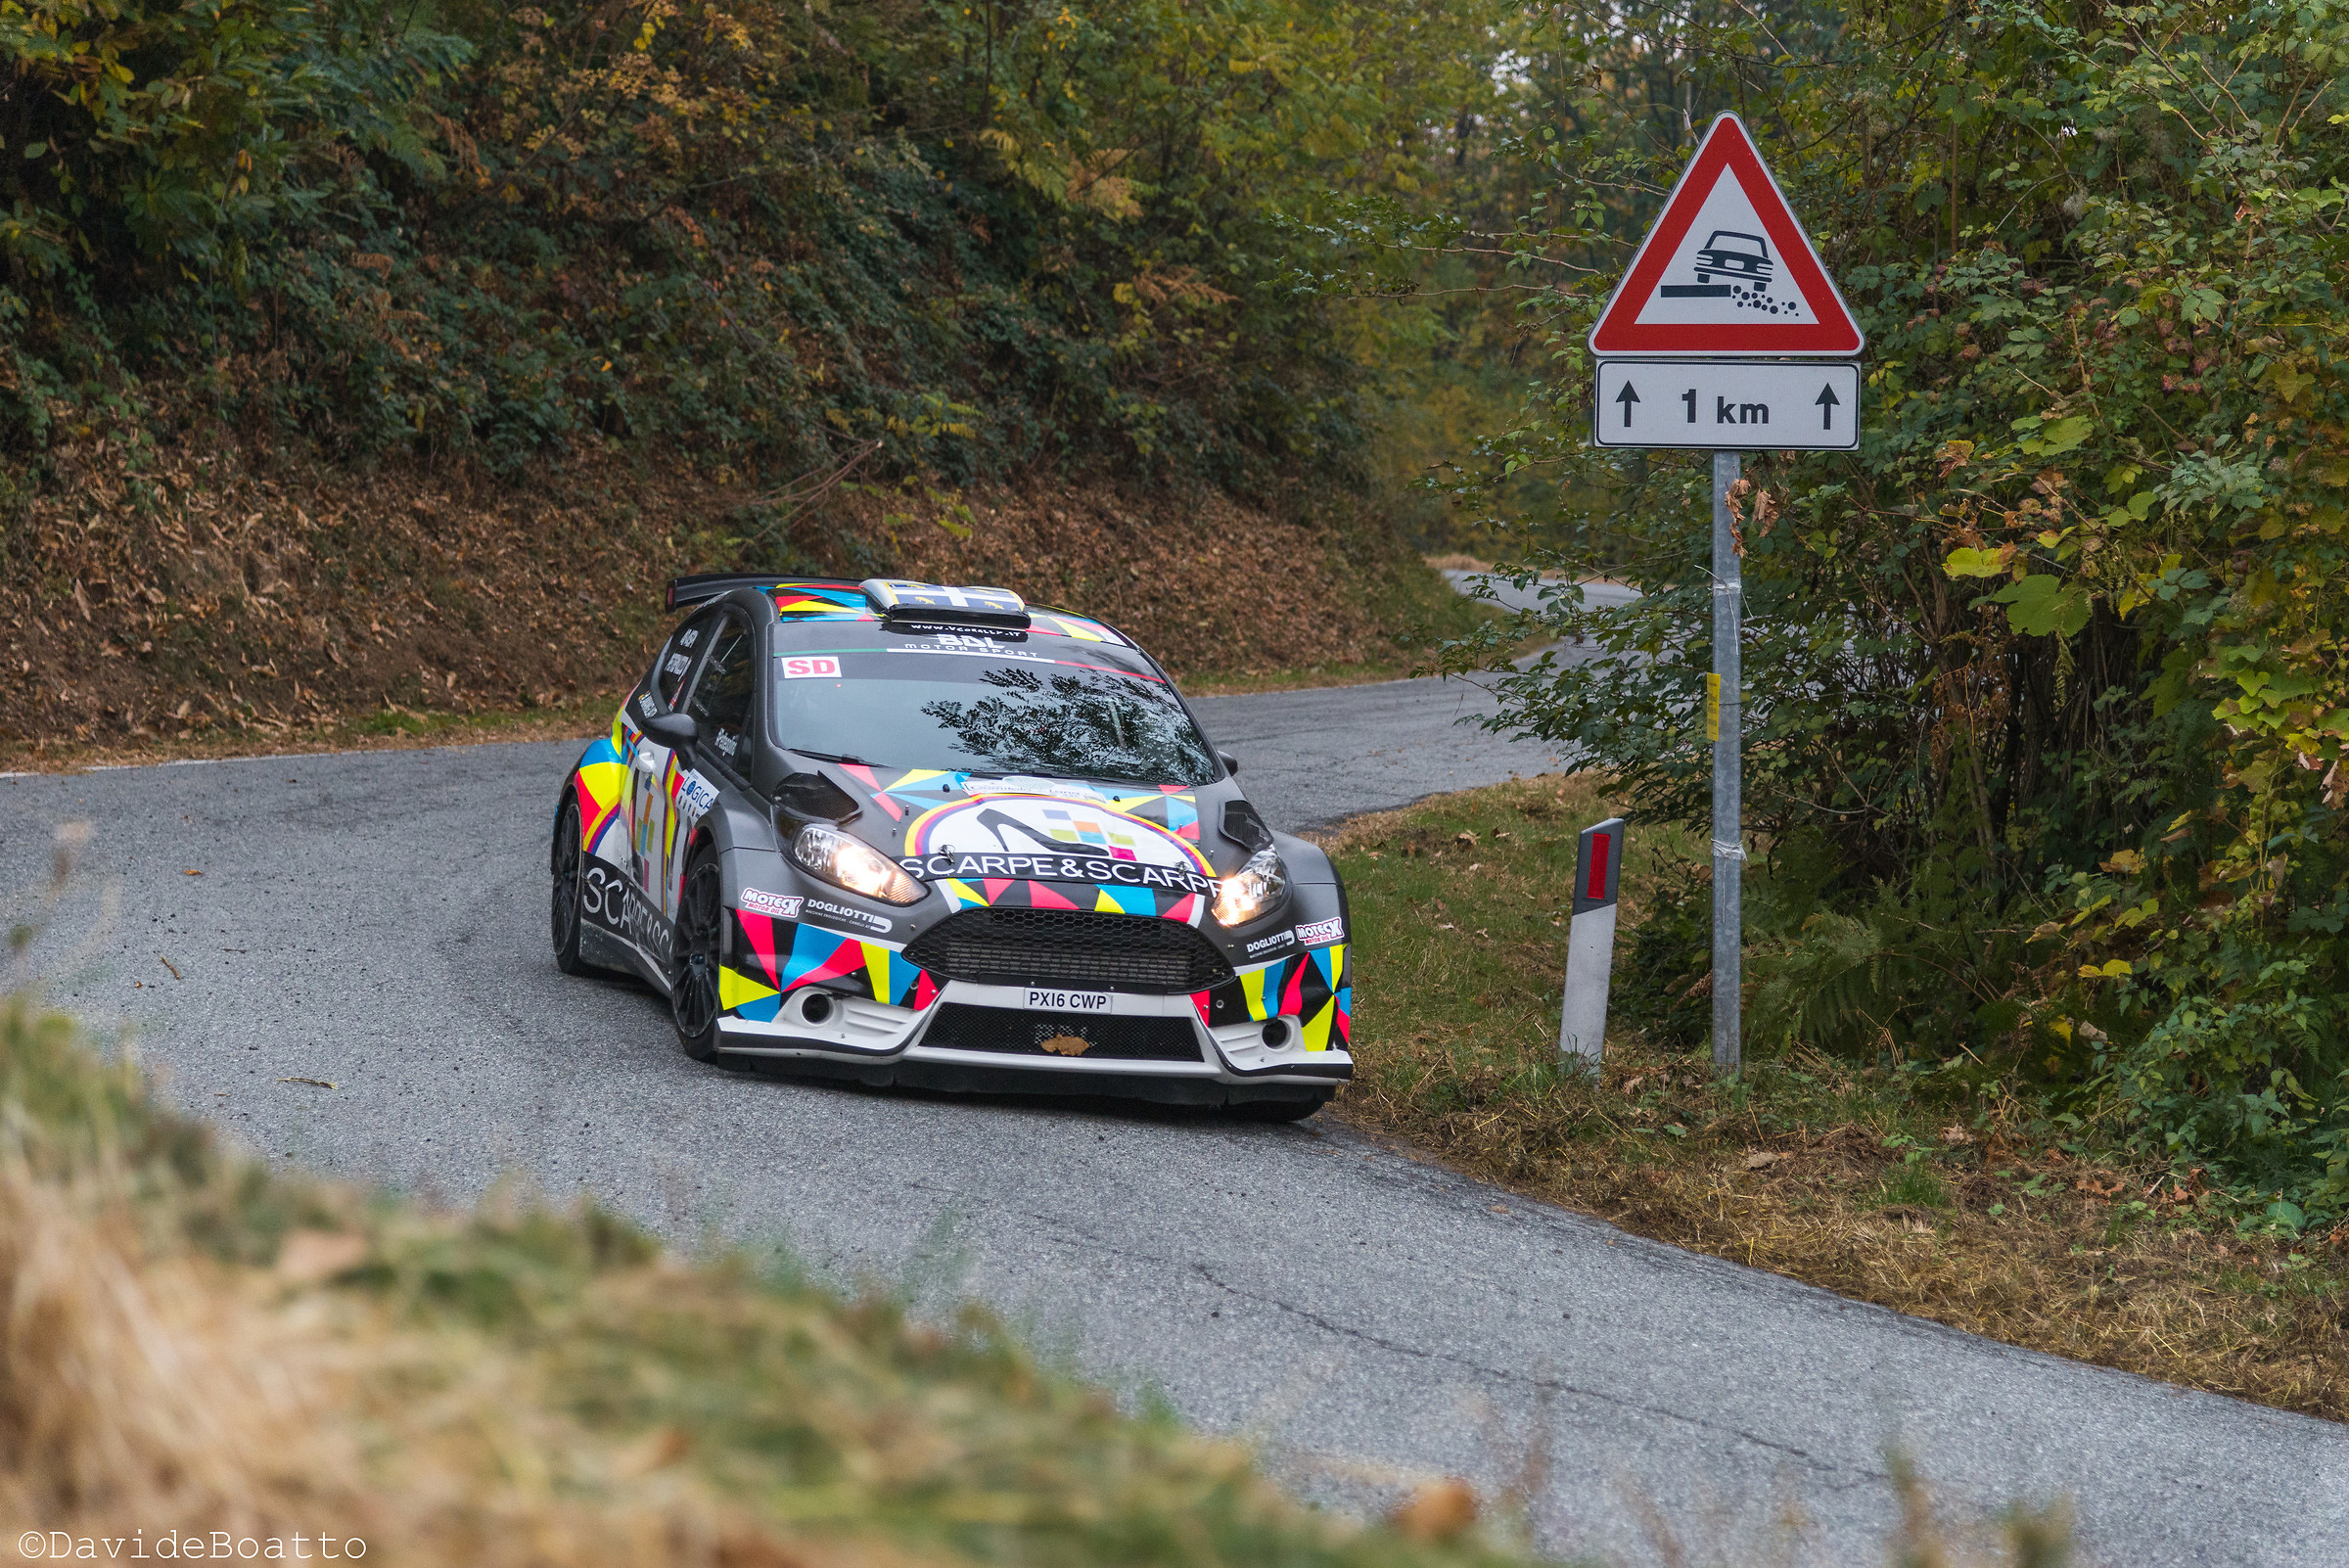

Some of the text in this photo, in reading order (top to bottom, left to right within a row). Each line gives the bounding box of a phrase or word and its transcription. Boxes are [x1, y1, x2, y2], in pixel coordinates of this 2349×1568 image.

[1681, 389, 1770, 424] 1 km
[979, 647, 1038, 658] SPORT
[786, 659, 838, 675] SD
[807, 899, 874, 923] DOGLIOTTI
[1070, 994, 1107, 1010] CWP
